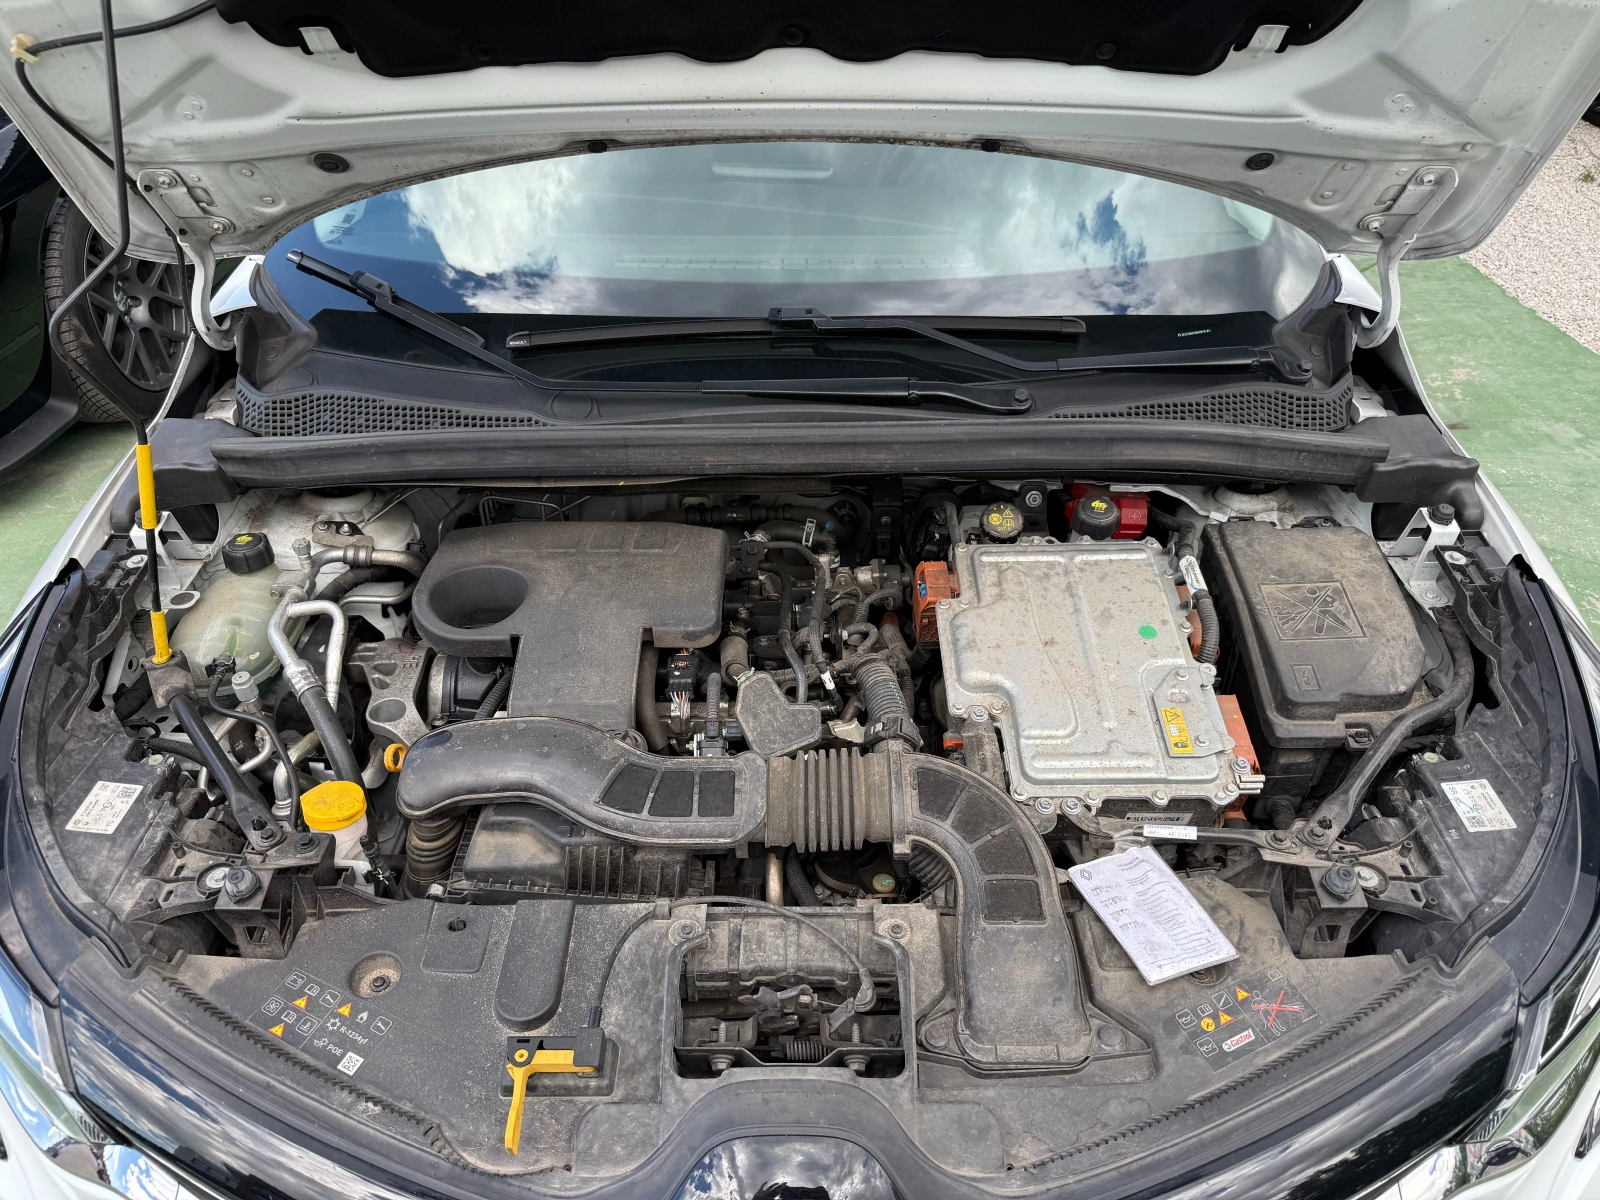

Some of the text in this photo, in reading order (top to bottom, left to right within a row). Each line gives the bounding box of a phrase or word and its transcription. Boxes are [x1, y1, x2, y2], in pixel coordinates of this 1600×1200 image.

[338, 1026, 369, 1045] R-1234yf
[1230, 1029, 1254, 1048] Castrol
[327, 1043, 344, 1057] POE
